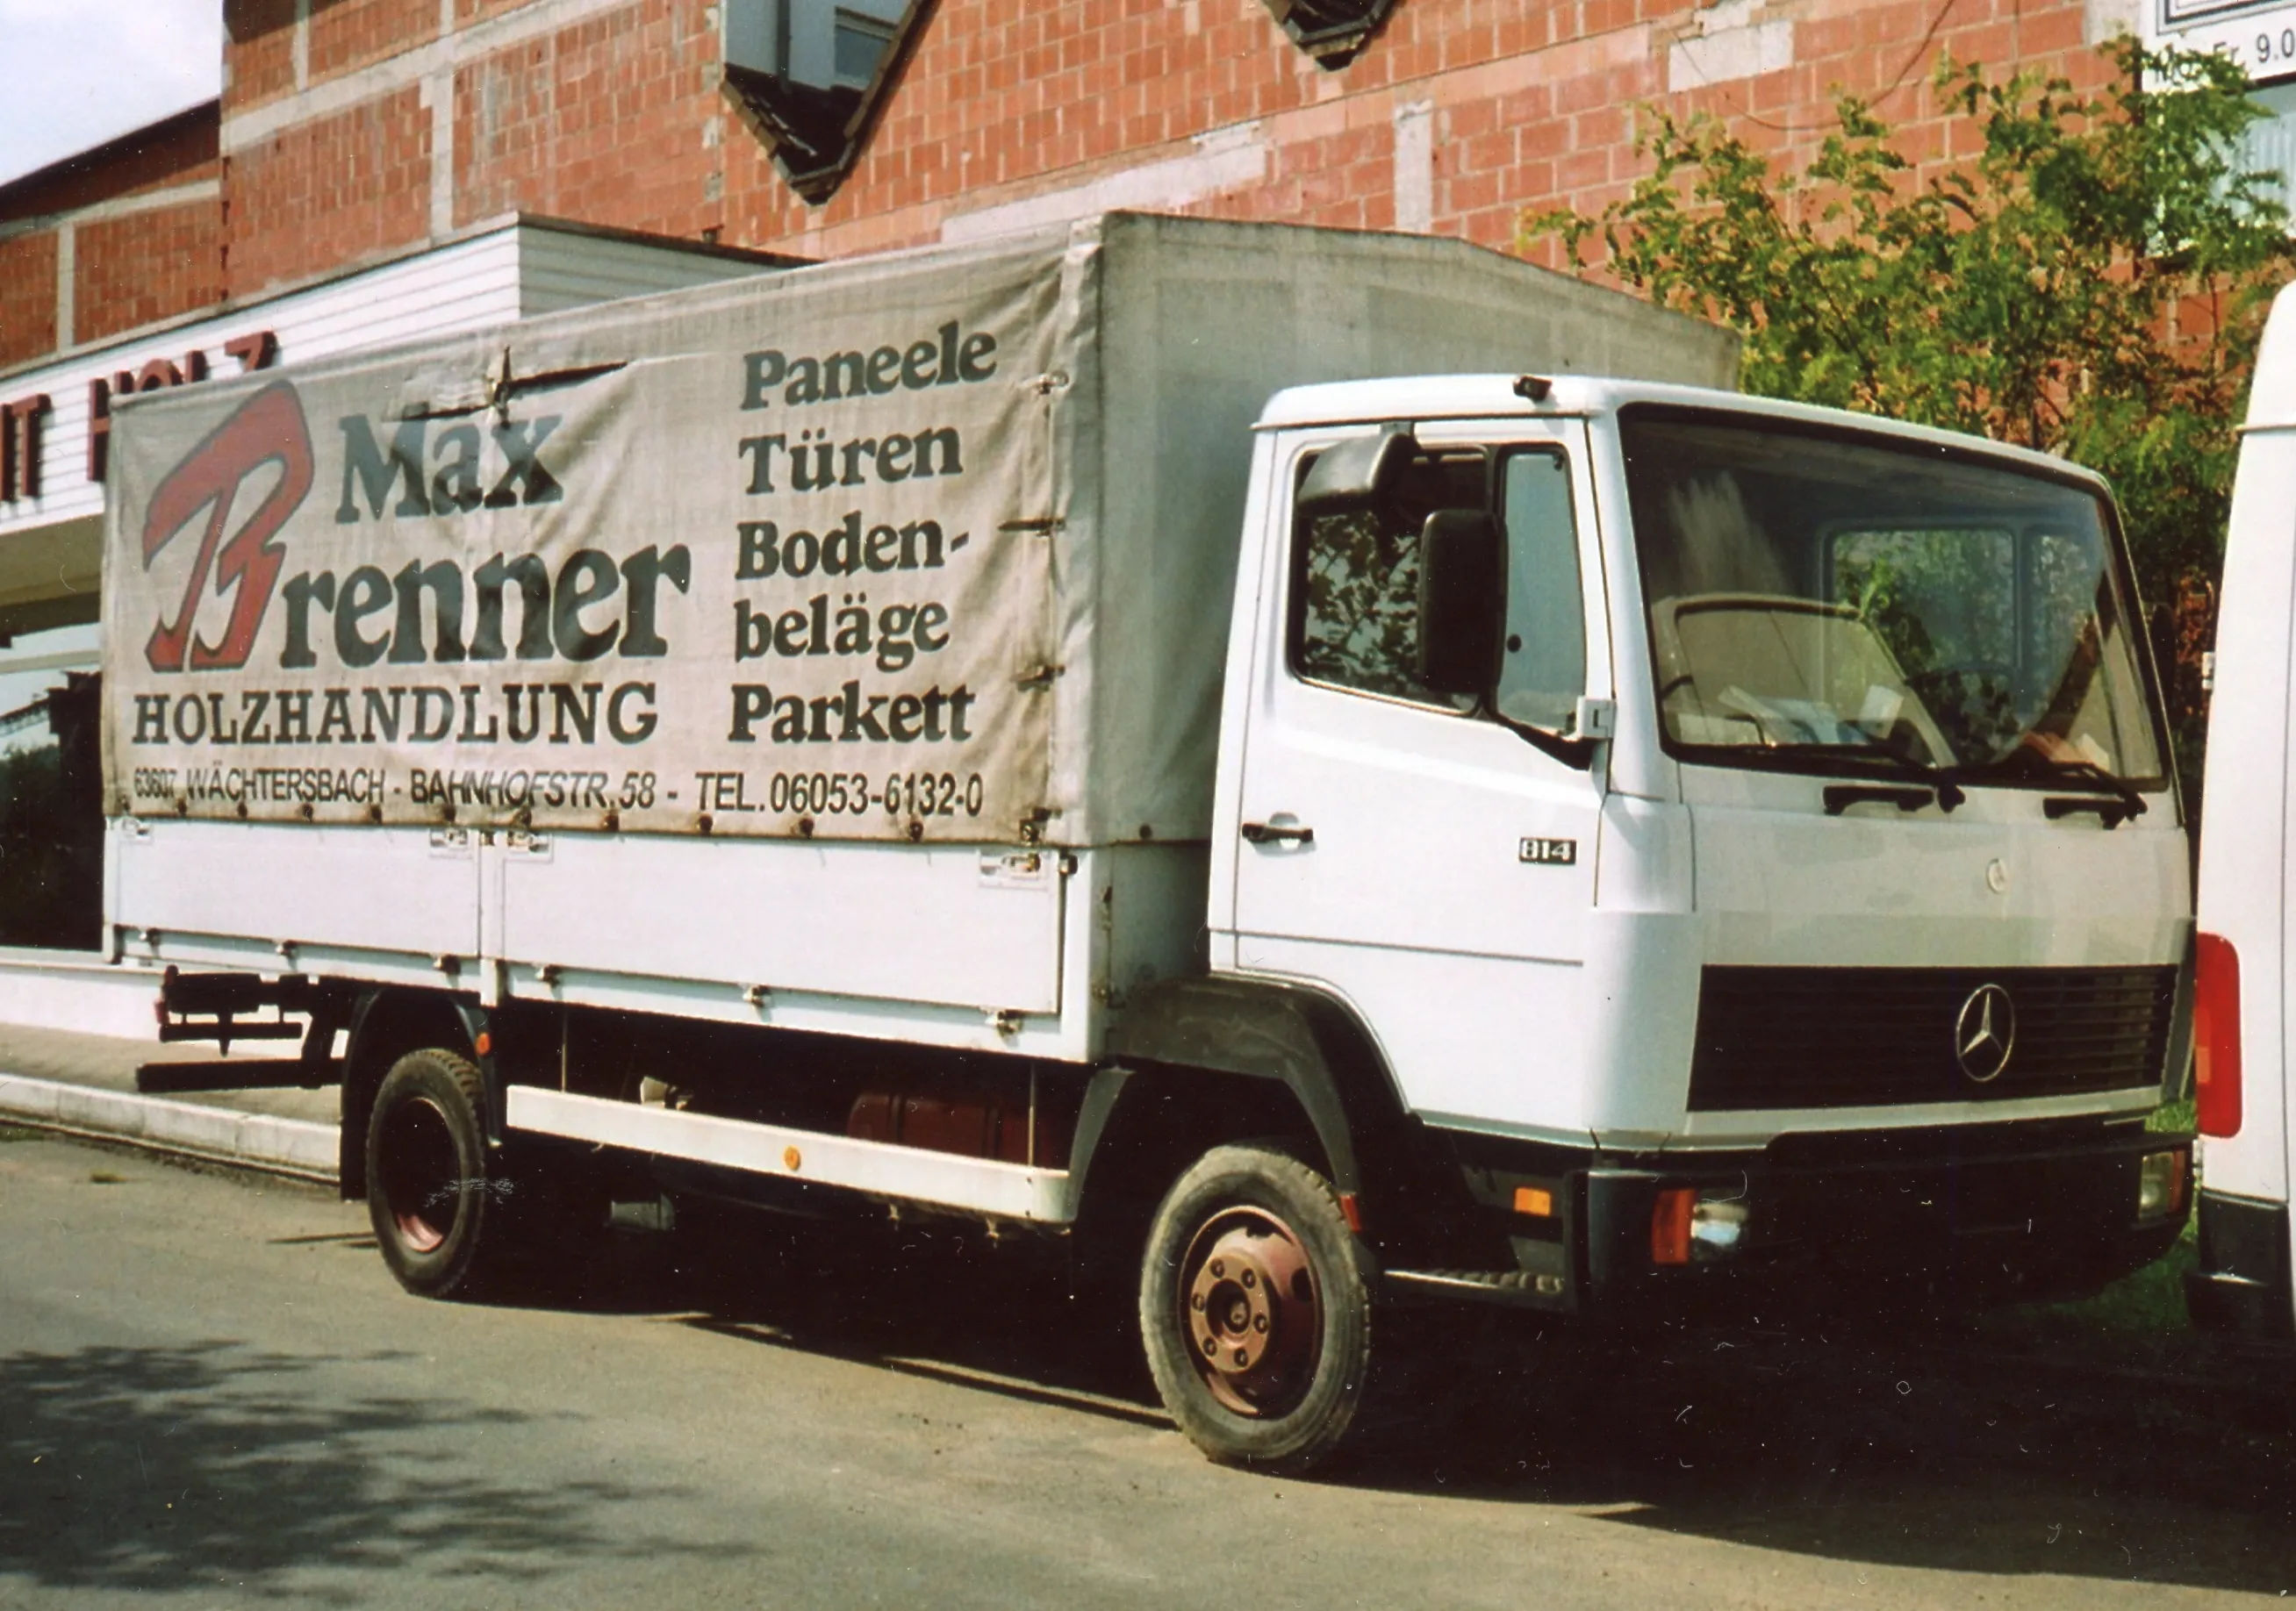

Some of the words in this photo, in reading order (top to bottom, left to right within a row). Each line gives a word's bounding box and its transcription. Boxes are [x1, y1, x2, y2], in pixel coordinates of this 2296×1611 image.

[740, 320, 997, 411] Paneele
[334, 407, 564, 525] Max
[738, 427, 963, 495] Türen
[735, 510, 969, 580] Boden-
[734, 592, 950, 673] beläge
[132, 682, 658, 745] HOLZHANDLUNG
[728, 680, 976, 743] Parkett
[186, 760, 385, 803] WÄCHTERSBACH
[1522, 839, 1571, 862] 814
